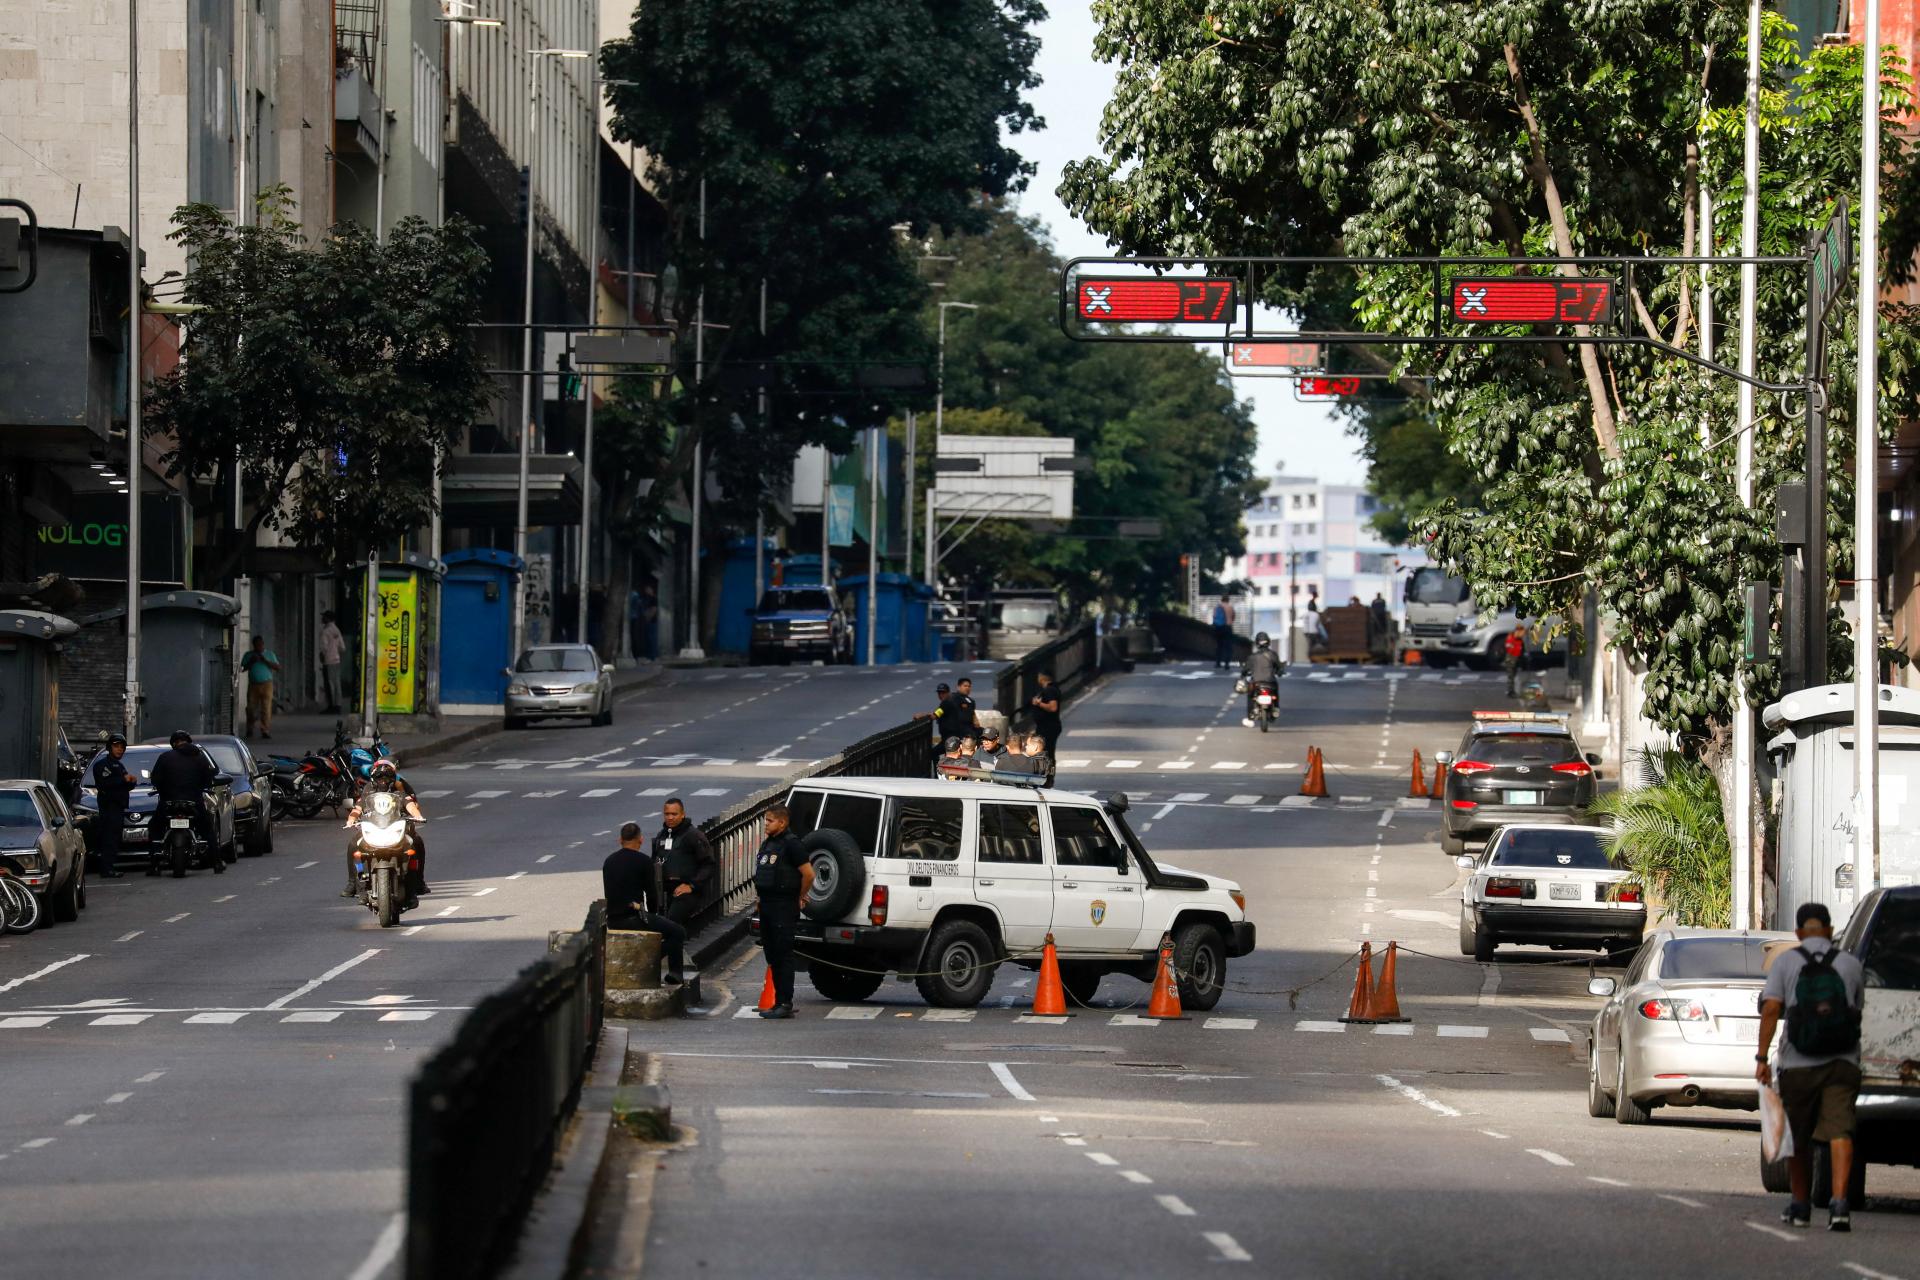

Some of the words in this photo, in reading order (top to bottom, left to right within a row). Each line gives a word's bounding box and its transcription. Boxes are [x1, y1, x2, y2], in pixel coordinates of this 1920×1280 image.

[1184, 281, 1232, 321] 27
[1560, 283, 1608, 322] 27
[37, 523, 128, 546] NOLOG
[384, 617, 400, 631] &
[381, 635, 399, 696] Esencia
